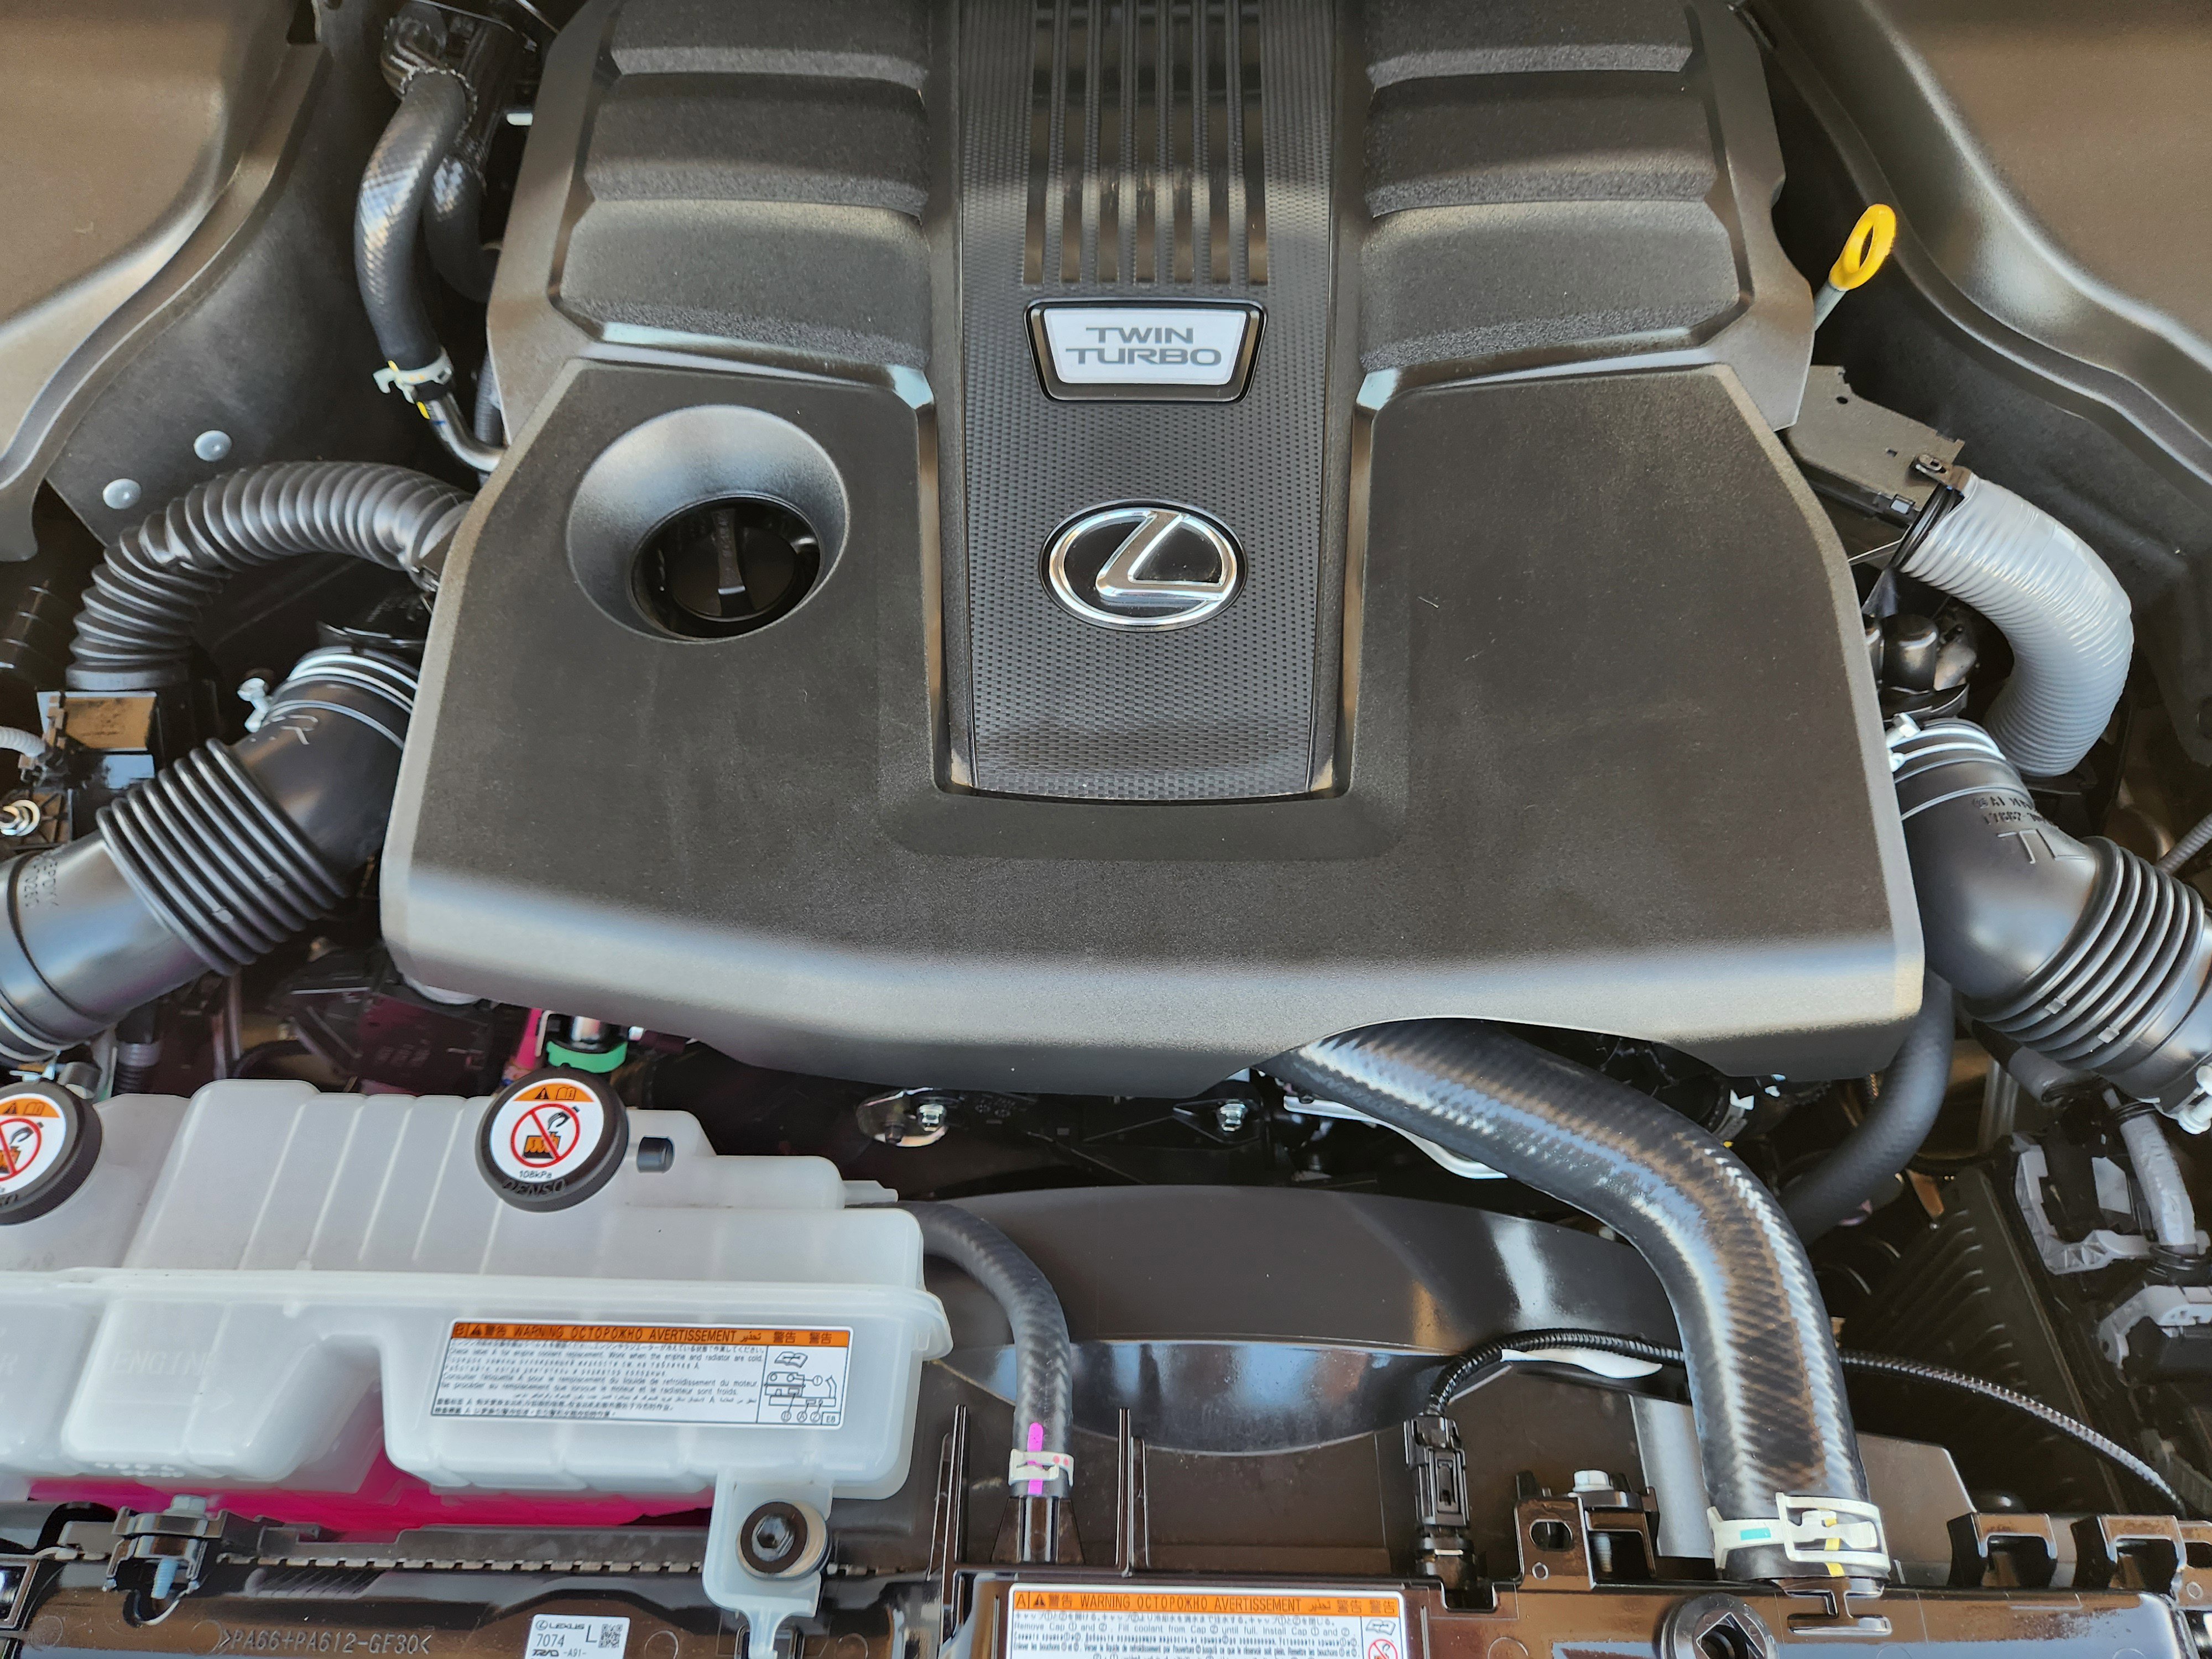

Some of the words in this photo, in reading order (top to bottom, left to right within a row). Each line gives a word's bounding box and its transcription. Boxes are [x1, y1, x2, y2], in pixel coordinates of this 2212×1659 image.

[1086, 327, 1194, 344] TWIN
[1065, 348, 1222, 366] TURBO
[502, 1178, 567, 1196] DENSO
[648, 1328, 737, 1343] AVERTISSEMENT
[1080, 1594, 1130, 1609] WARNING
[1214, 1597, 1302, 1613] AVERTISSEMENT
[585, 1624, 598, 1643] L
[1134, 1624, 1162, 1632] coolant
[1291, 1626, 1307, 1636] Cap
[1323, 1627, 1338, 1636] and
[536, 1633, 566, 1647] 7074
